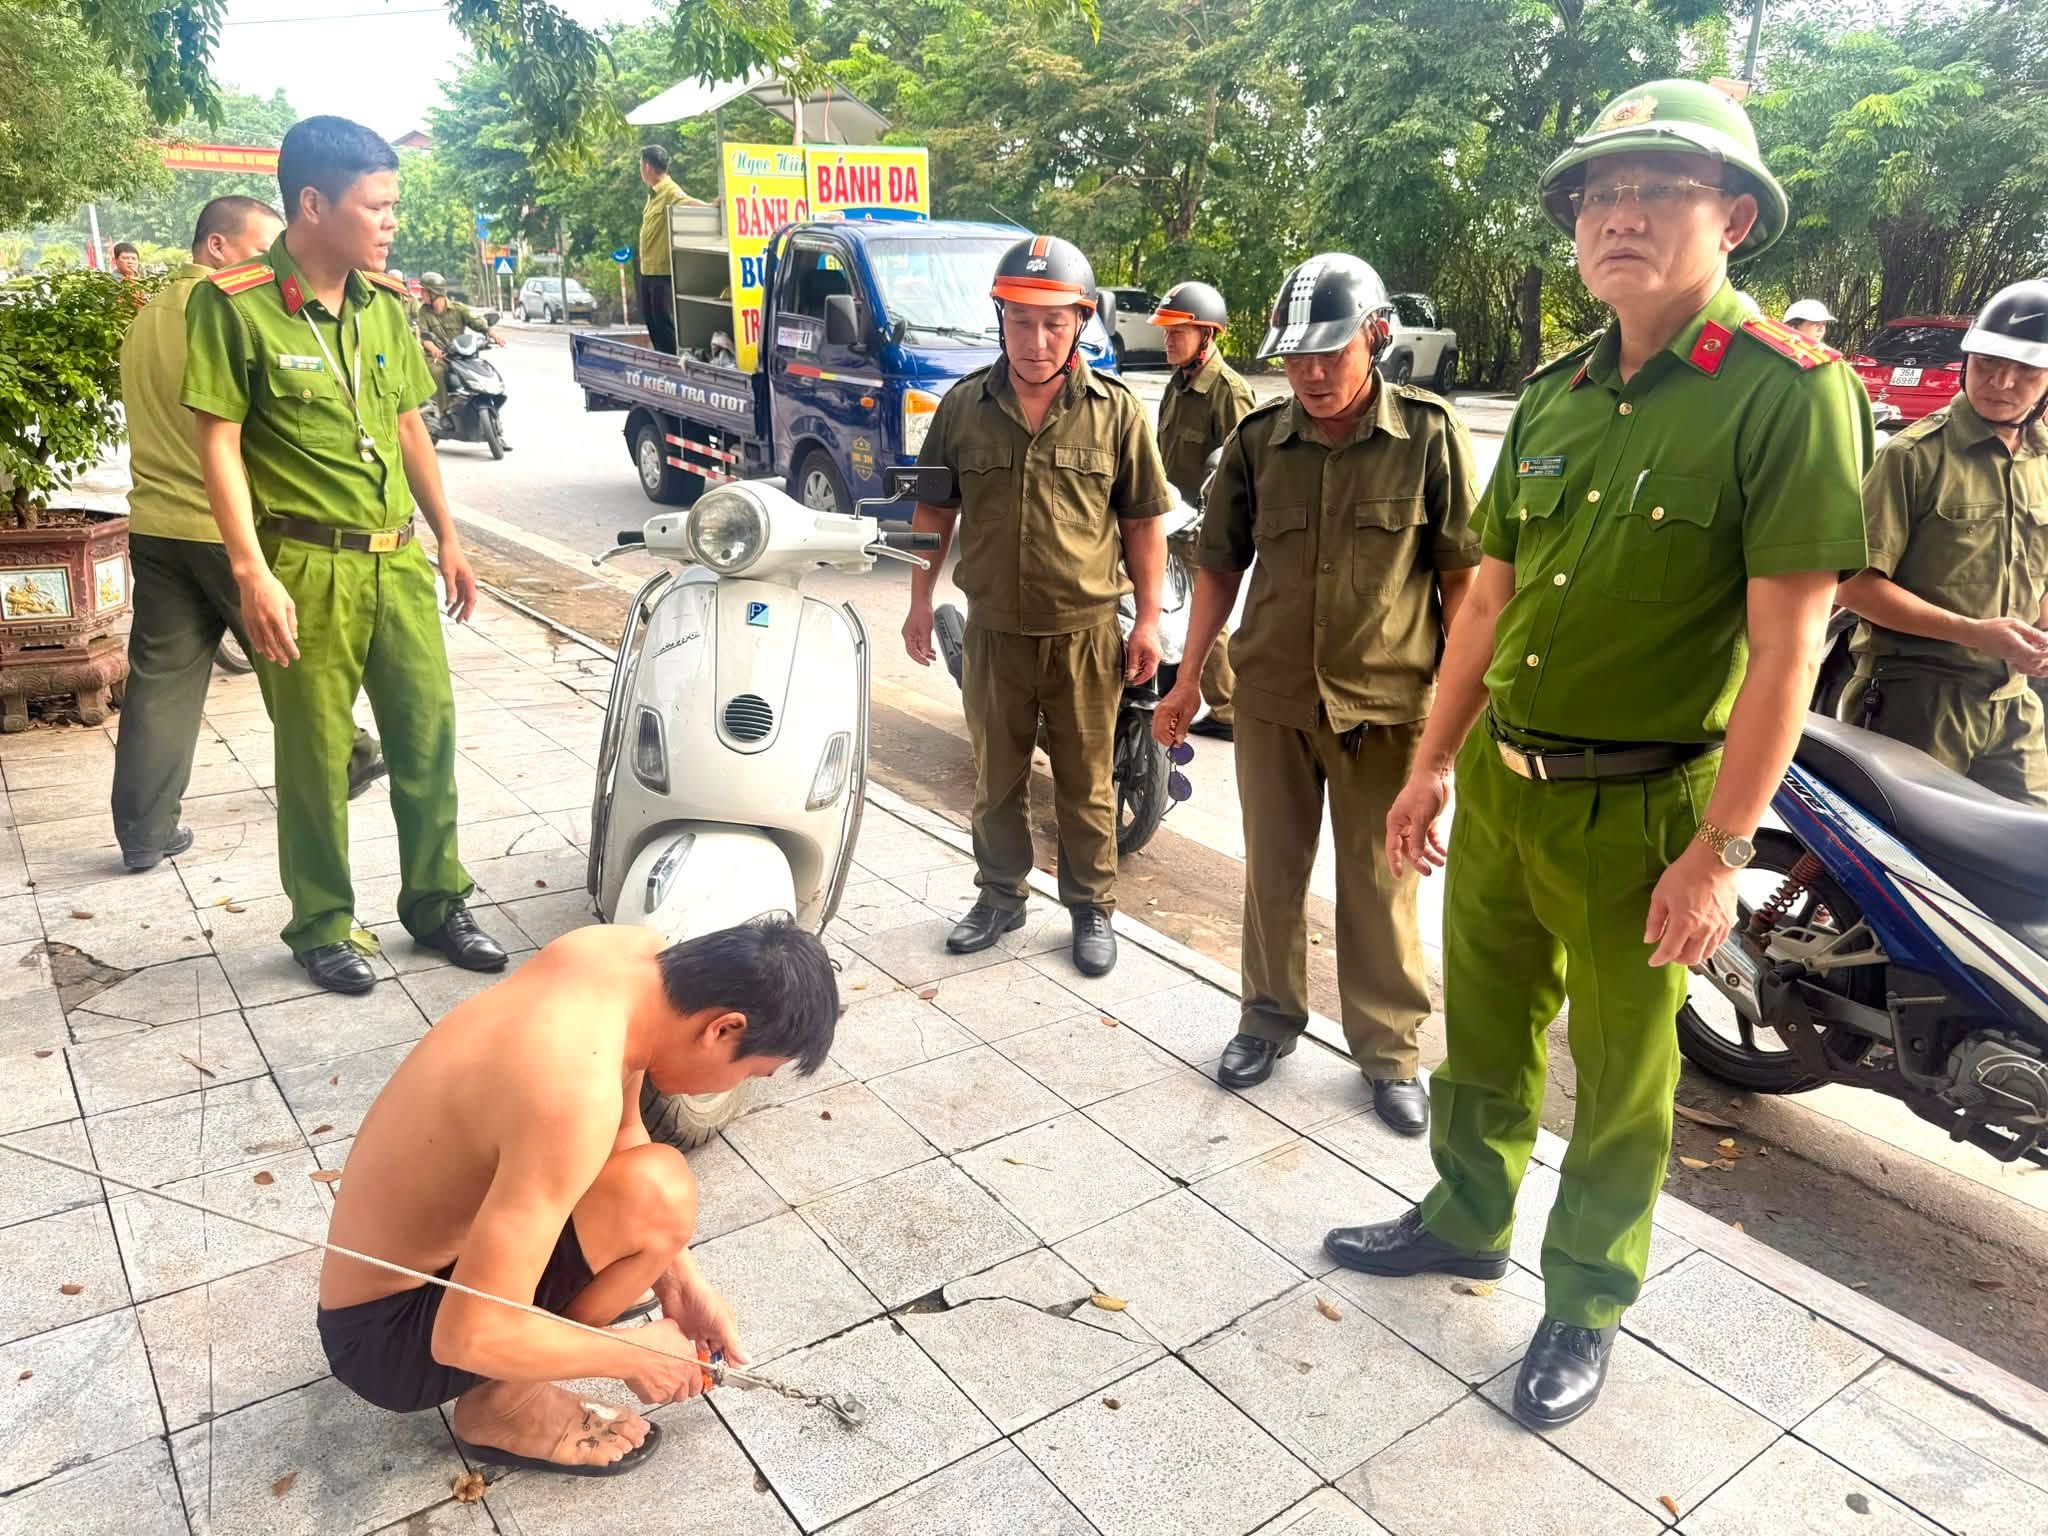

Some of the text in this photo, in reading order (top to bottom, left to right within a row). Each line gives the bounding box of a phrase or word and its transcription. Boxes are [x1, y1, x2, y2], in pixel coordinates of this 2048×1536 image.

[817, 157, 919, 204] BÁNH ĐA
[625, 369, 643, 386] TỔ
[642, 374, 677, 396] KIỂM
[680, 384, 706, 403] TRA
